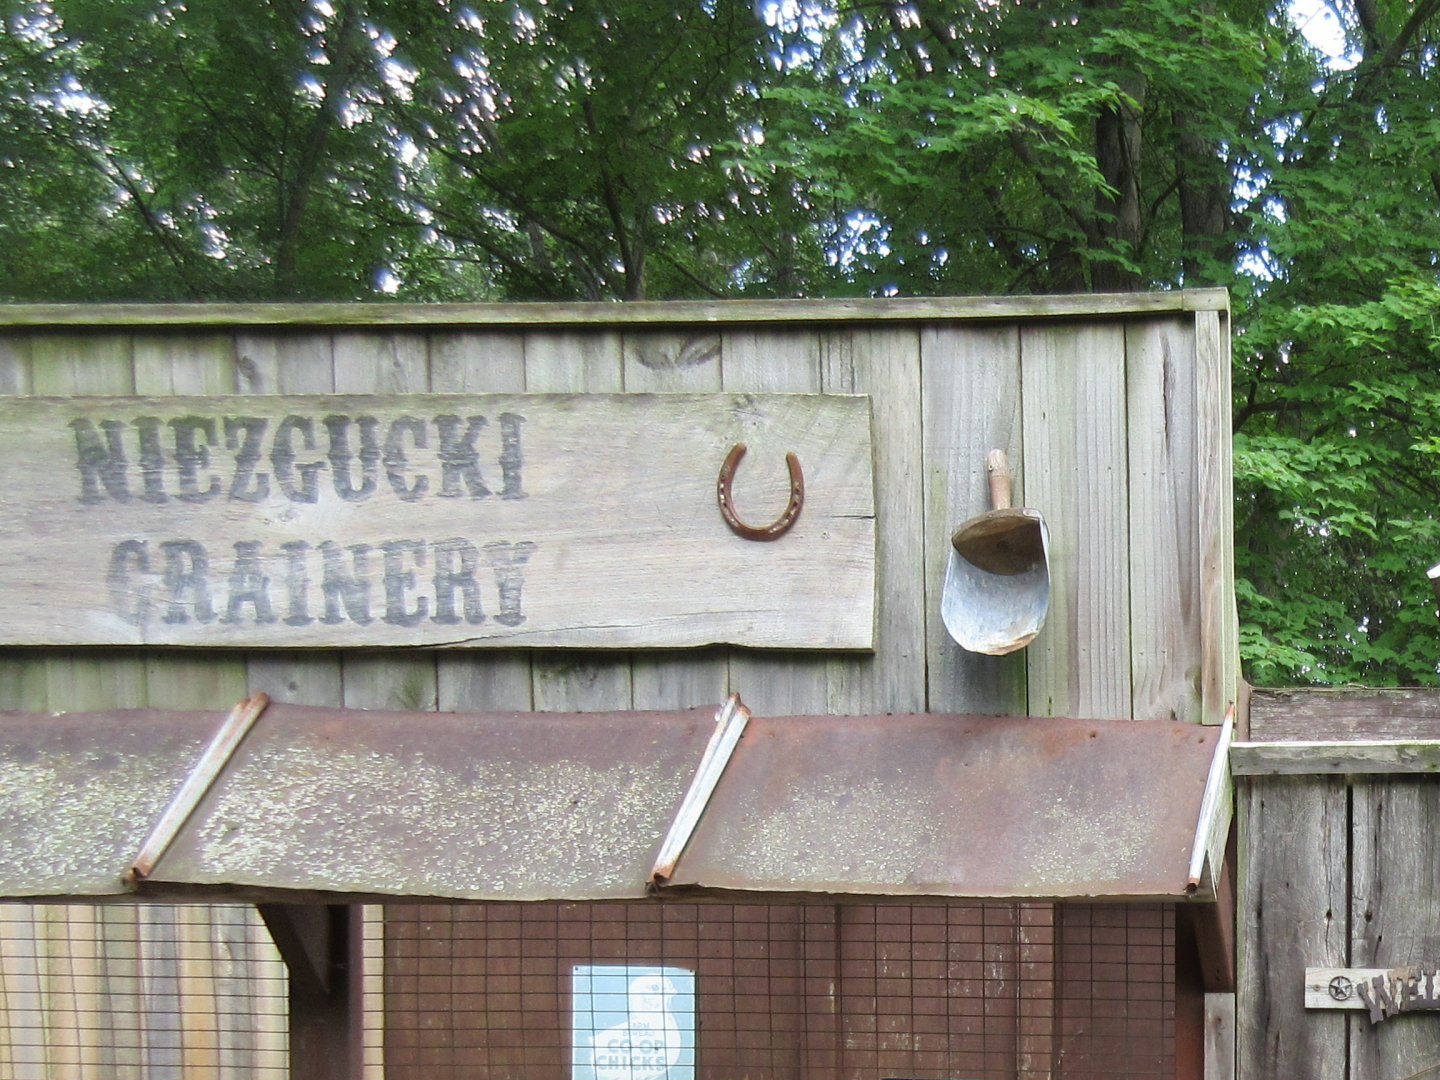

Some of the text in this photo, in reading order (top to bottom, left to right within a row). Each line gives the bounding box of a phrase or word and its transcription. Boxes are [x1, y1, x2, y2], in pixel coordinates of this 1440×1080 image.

[68, 412, 529, 505] NIEZGUCKI
[107, 538, 537, 627] GRAINERY
[597, 1055, 665, 1070] CHICKS
[608, 1039, 664, 1053] CO-OP
